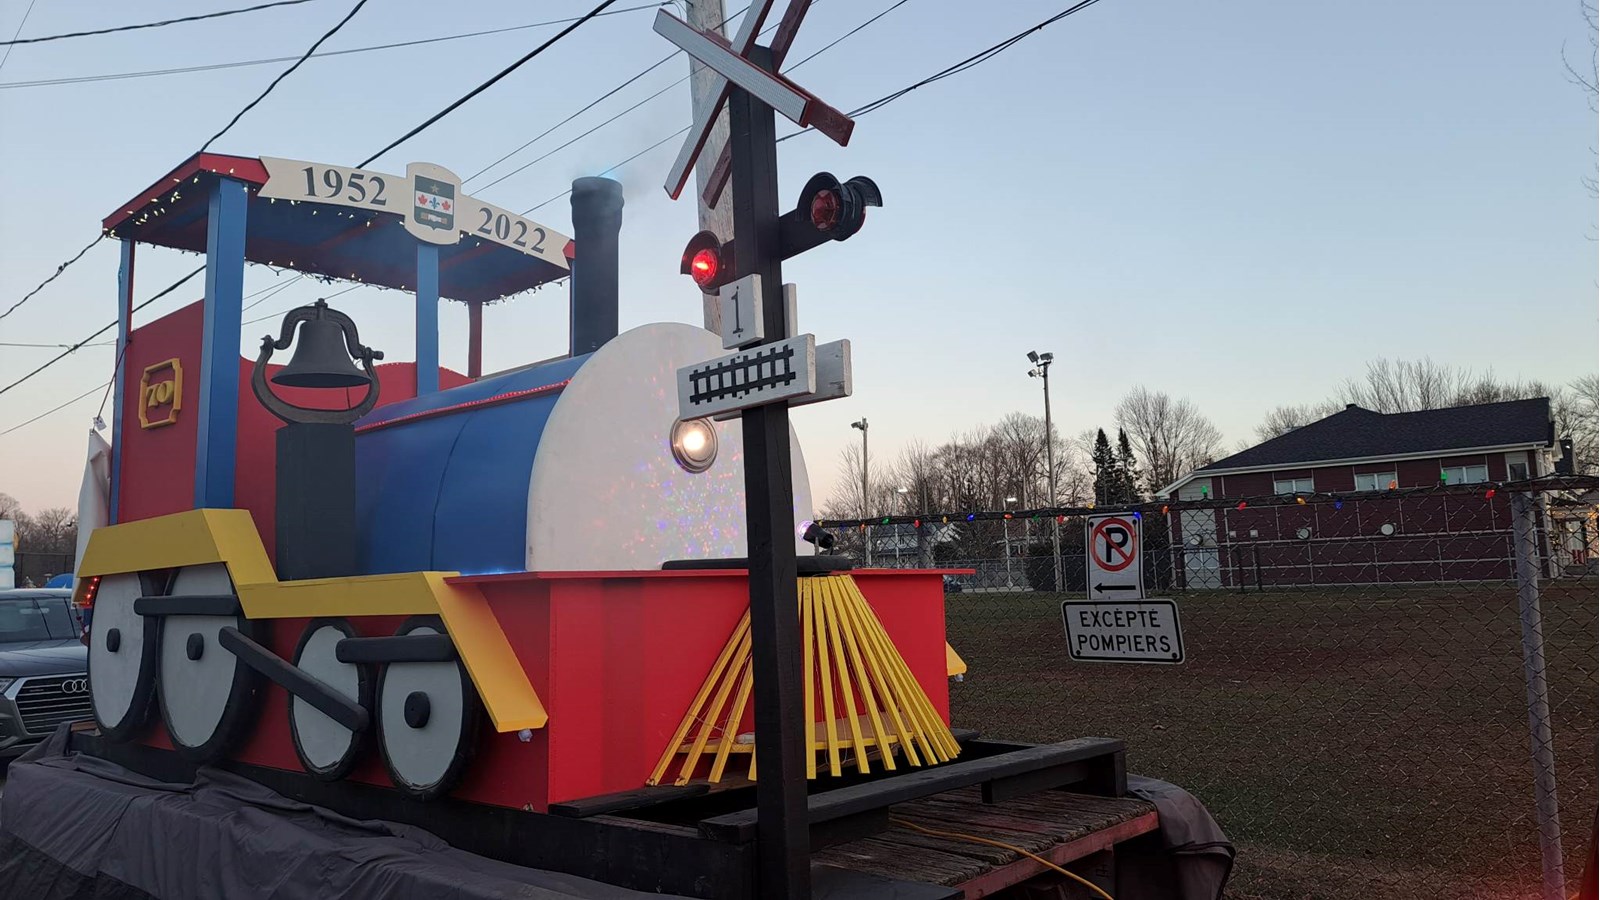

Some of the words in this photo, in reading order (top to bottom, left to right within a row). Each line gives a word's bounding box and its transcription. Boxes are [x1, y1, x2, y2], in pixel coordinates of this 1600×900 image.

[302, 166, 387, 206] 1952
[477, 207, 546, 254] 2022
[731, 291, 743, 334] 1
[146, 381, 175, 407] 70
[1105, 527, 1129, 563] P
[1077, 634, 1171, 653] POMPIERS
